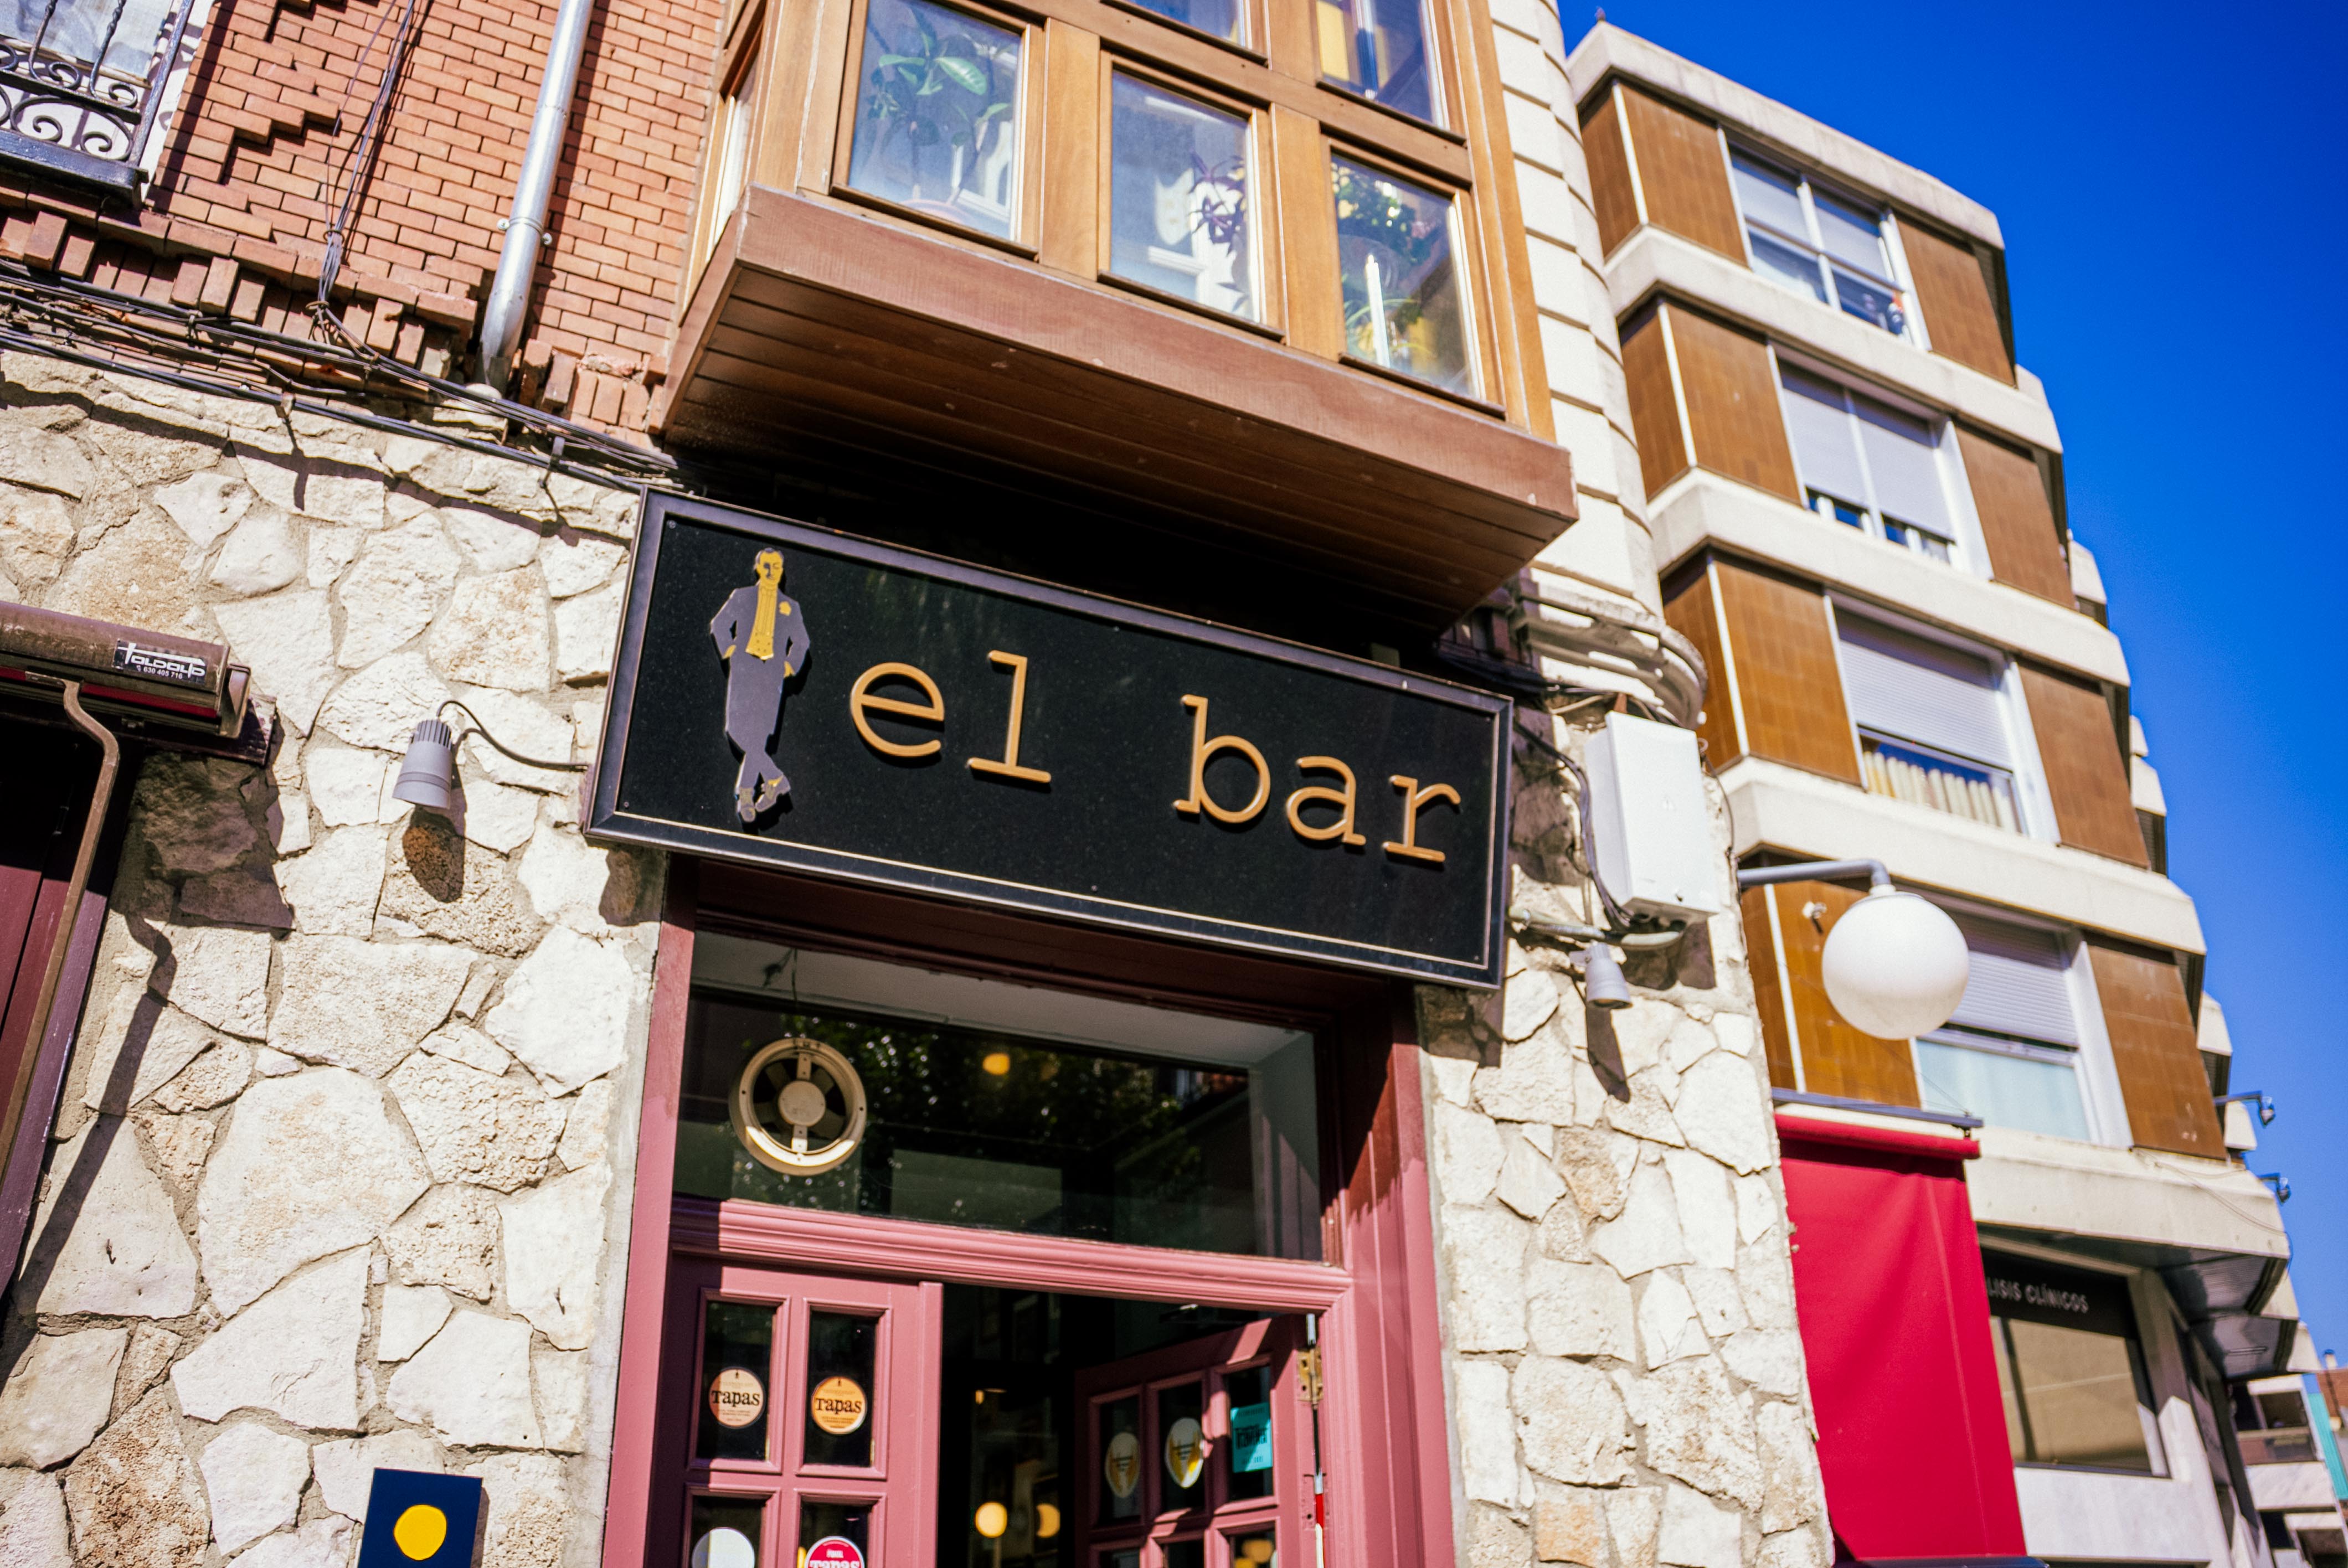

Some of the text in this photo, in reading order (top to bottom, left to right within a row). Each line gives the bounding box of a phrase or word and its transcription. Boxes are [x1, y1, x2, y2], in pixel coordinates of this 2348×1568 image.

[849, 649, 1461, 863] el bar
[1986, 1277, 2022, 1301] LISIS
[711, 1390, 760, 1407] Tapas
[815, 1398, 862, 1414] Tapas
